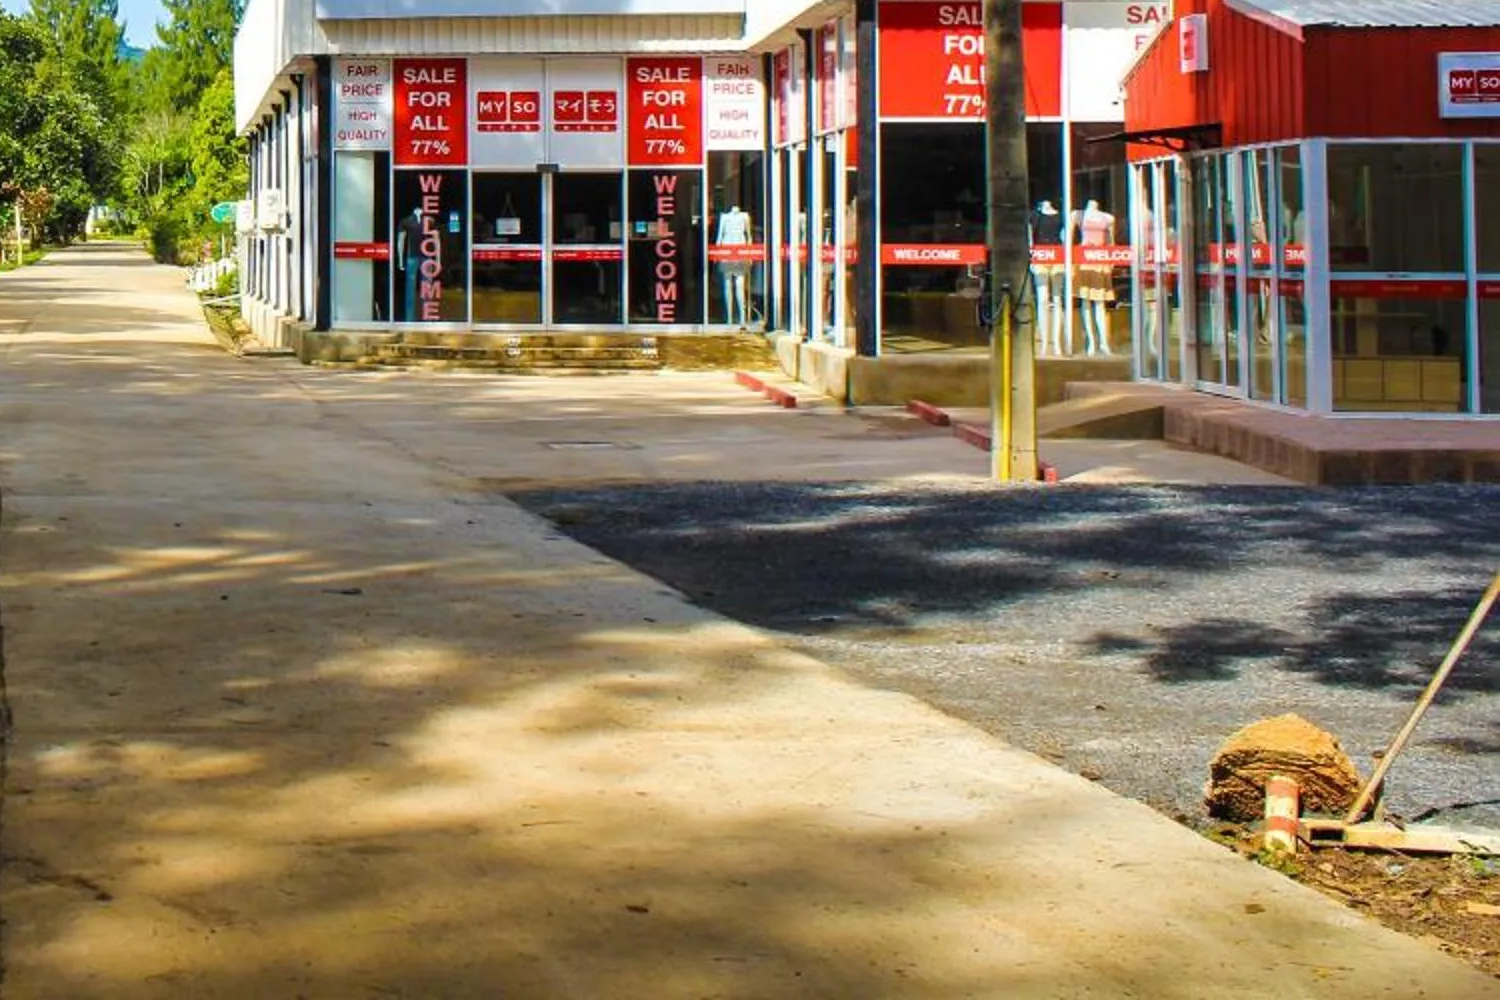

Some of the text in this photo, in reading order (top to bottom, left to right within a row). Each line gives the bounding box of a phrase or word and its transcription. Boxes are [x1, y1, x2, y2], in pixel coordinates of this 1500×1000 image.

[938, 4, 985, 26] SAL
[347, 64, 378, 78] FAIR
[403, 67, 457, 85] SALE
[636, 66, 691, 83] SALE
[713, 83, 756, 96] PRICE
[1451, 76, 1500, 89] MY SO
[341, 83, 384, 98] PRICE
[641, 89, 687, 107] FOR
[407, 91, 451, 108] FOR
[479, 100, 537, 114] MY SO
[348, 111, 378, 122] HIGH
[410, 115, 450, 131] ALL
[644, 113, 685, 130] ALL
[338, 129, 388, 142] QUALITY
[709, 129, 759, 141] QUALITY
[411, 139, 451, 156] 77%
[645, 138, 686, 155] 77%
[418, 173, 443, 321] WELCOME
[653, 175, 678, 323] WELCOME
[892, 248, 961, 261] WELCOME
[1030, 249, 1056, 262] PEN
[1083, 249, 1133, 262] WELCO
